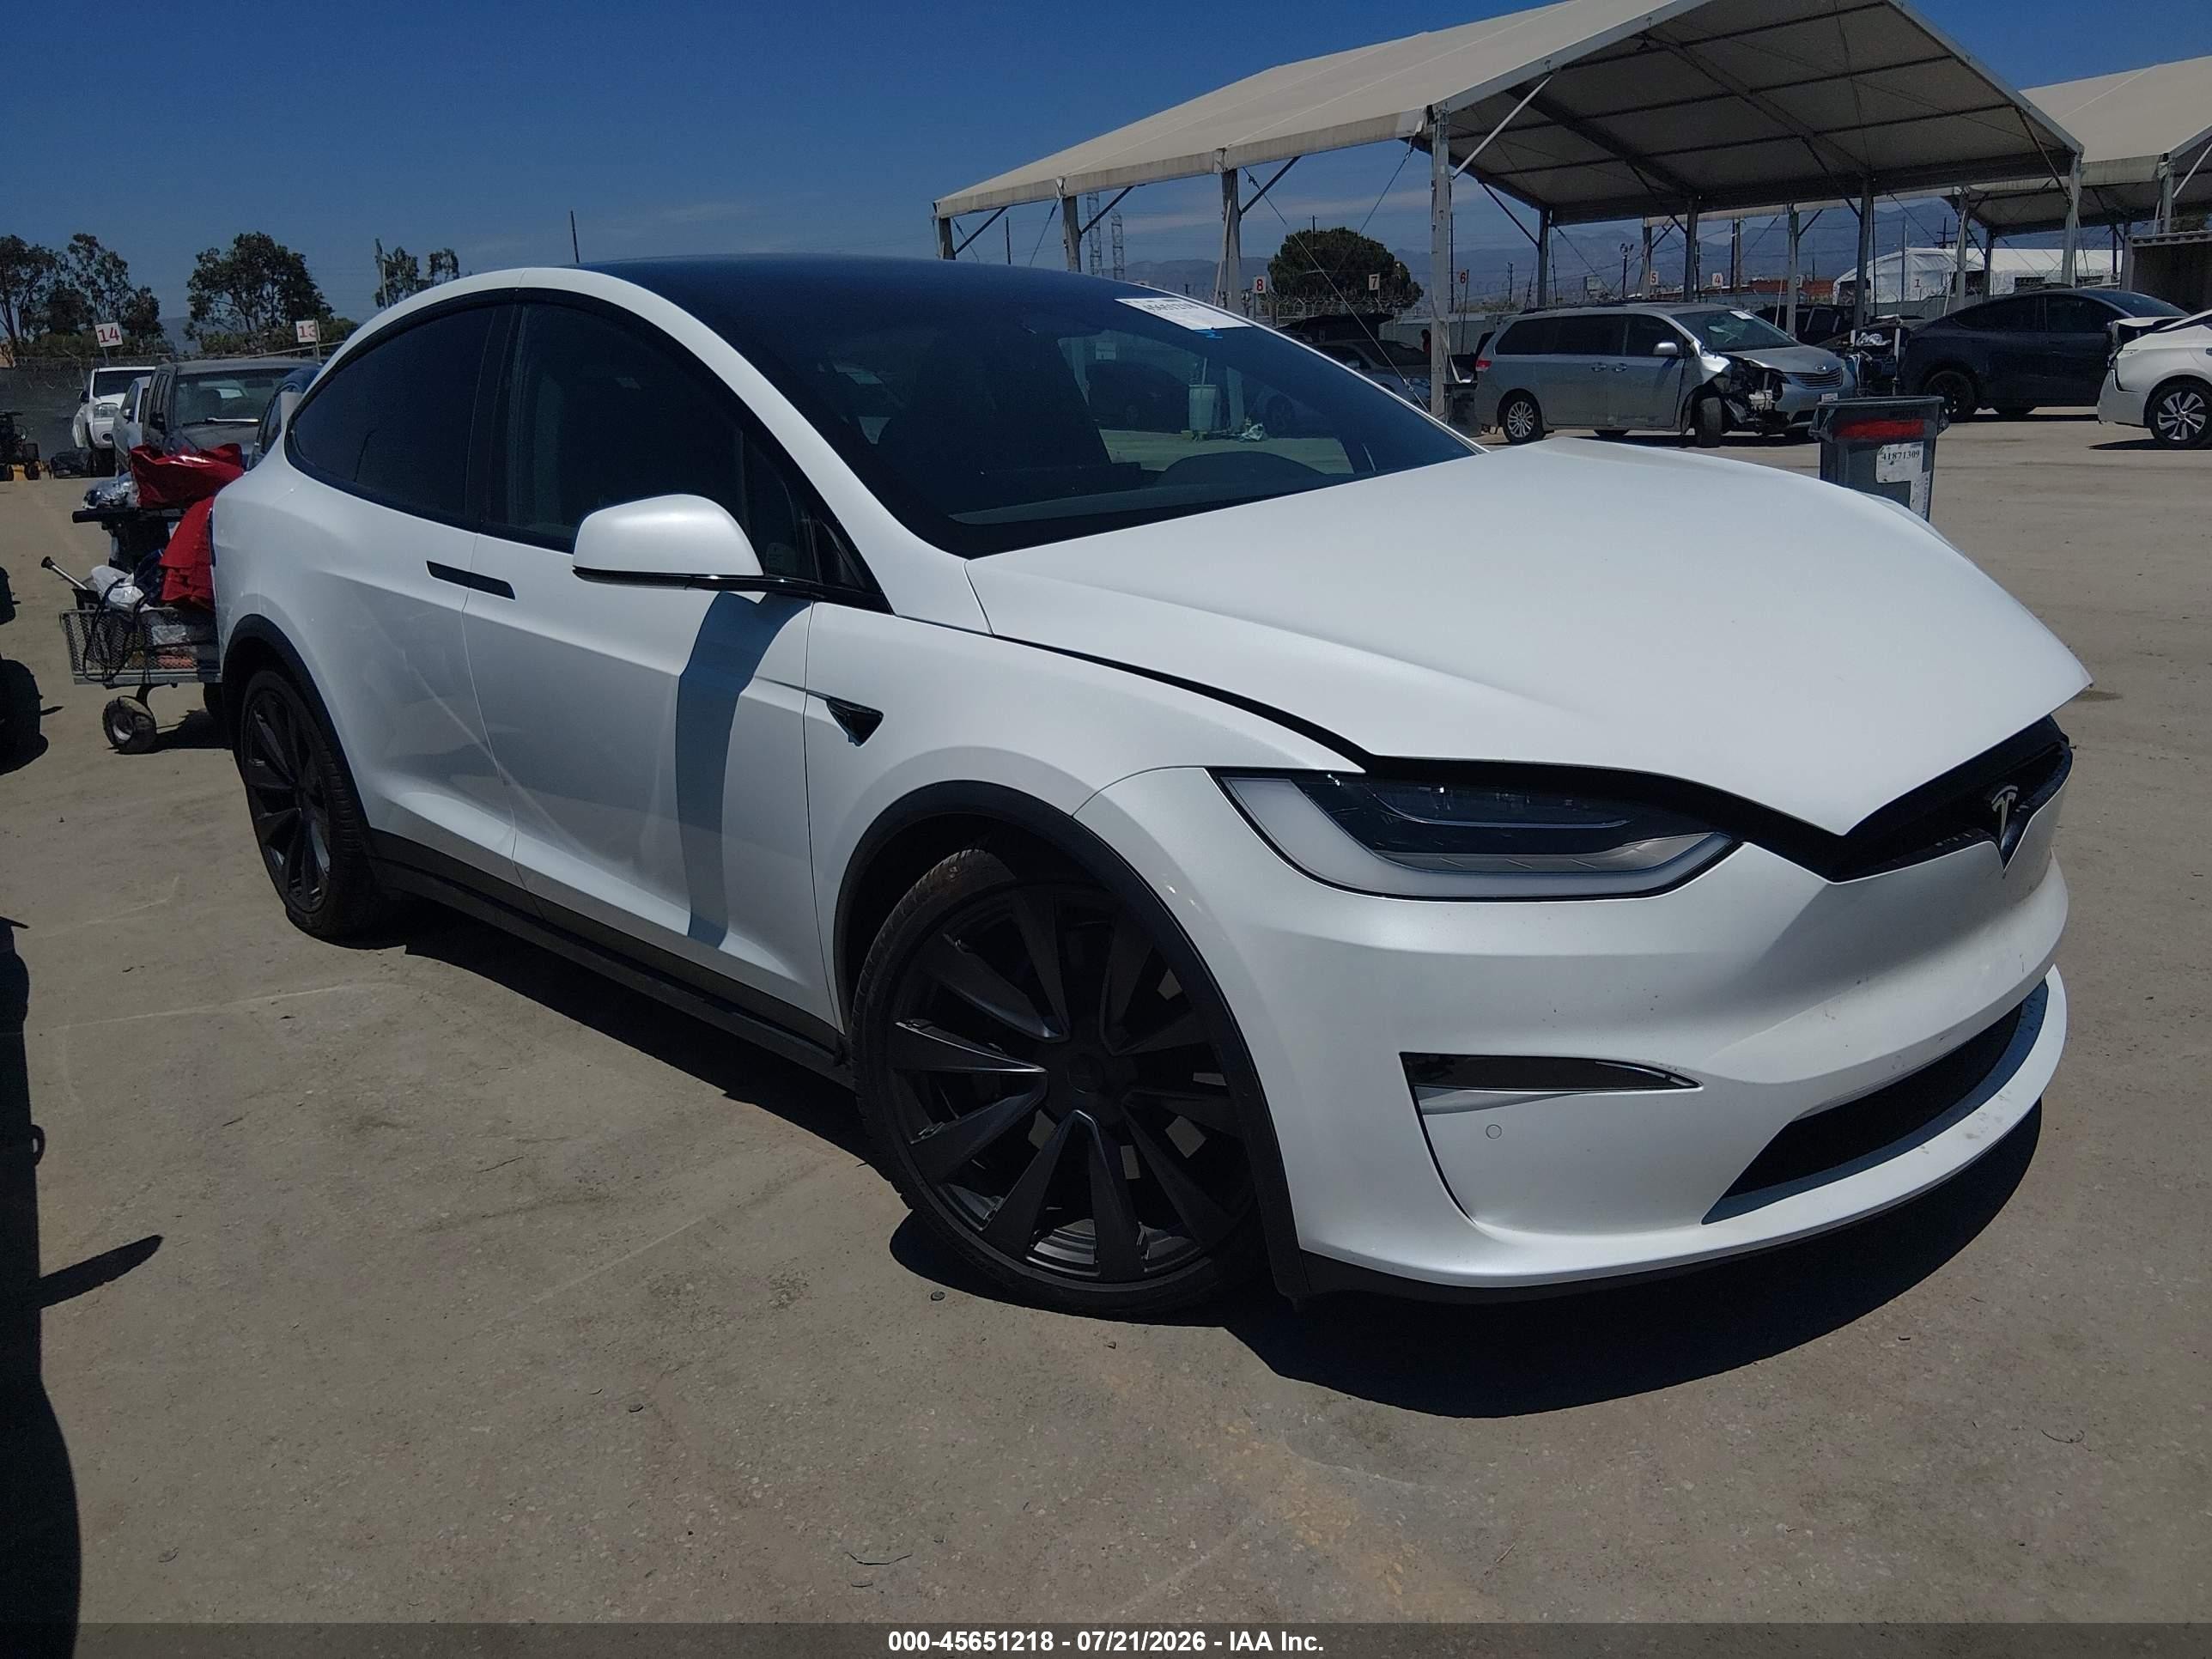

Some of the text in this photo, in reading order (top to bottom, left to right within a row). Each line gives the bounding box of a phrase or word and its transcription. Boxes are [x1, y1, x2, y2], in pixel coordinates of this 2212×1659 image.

[1370, 276, 1377, 289] 7
[1460, 271, 1466, 283] 6
[1651, 272, 1656, 283] 5
[1256, 278, 1263, 291] 8
[98, 326, 120, 343] 14
